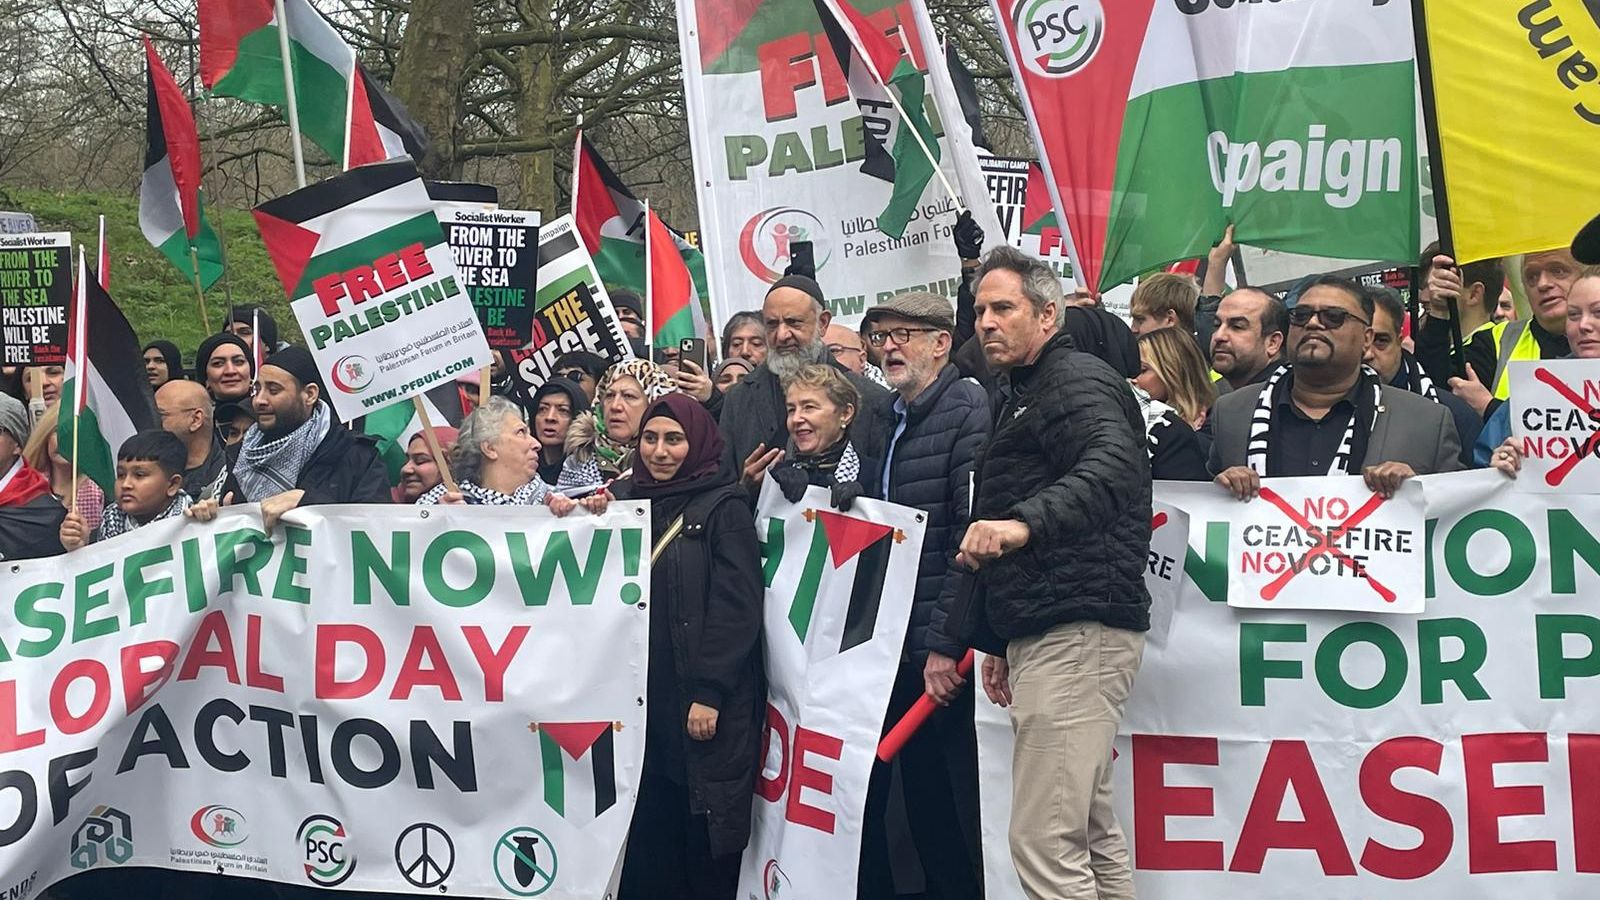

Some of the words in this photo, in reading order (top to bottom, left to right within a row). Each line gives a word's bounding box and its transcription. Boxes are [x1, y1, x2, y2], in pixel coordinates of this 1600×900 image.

[1028, 5, 1087, 51] PSC
[1010, 160, 1030, 170] CAMPA
[1207, 124, 1402, 209] Cpaign
[455, 211, 493, 223] Socialist
[494, 213, 526, 224] Worker
[27, 236, 57, 246] Worker
[450, 225, 493, 247] FROM
[497, 228, 526, 248] THE
[539, 221, 571, 243] ampaign
[0, 250, 29, 269] FROM
[32, 249, 59, 268] THE
[451, 245, 493, 266] RIVER
[497, 248, 517, 268] TO
[1, 269, 31, 288] RIVER
[34, 268, 53, 287] TO
[312, 242, 434, 317] FREE
[458, 266, 477, 286] HE
[481, 267, 509, 287] SEA
[1, 289, 20, 306] THE
[23, 287, 49, 306] SEA
[467, 287, 526, 307] LESTINE
[3, 306, 66, 326] PALESTINE
[310, 275, 461, 350] PALESTINE
[487, 307, 506, 327] BE
[543, 290, 588, 336] THE
[3, 326, 29, 344] WILL
[32, 325, 50, 344] BE
[5, 345, 31, 363] FREE
[379, 352, 421, 374] Palestinian
[420, 341, 444, 357] Forum
[452, 328, 478, 344] Britain
[361, 356, 476, 408] WWW.PFBUK.COM
[1304, 497, 1350, 521] NO
[1243, 525, 1413, 554] CEASEFIRE
[351, 528, 643, 606] NOW!
[315, 624, 531, 703] DAY
[1240, 620, 1491, 709] FOR
[116, 698, 478, 792] ACTION
[1130, 731, 1600, 880] EASE
[307, 838, 346, 864] PSC
